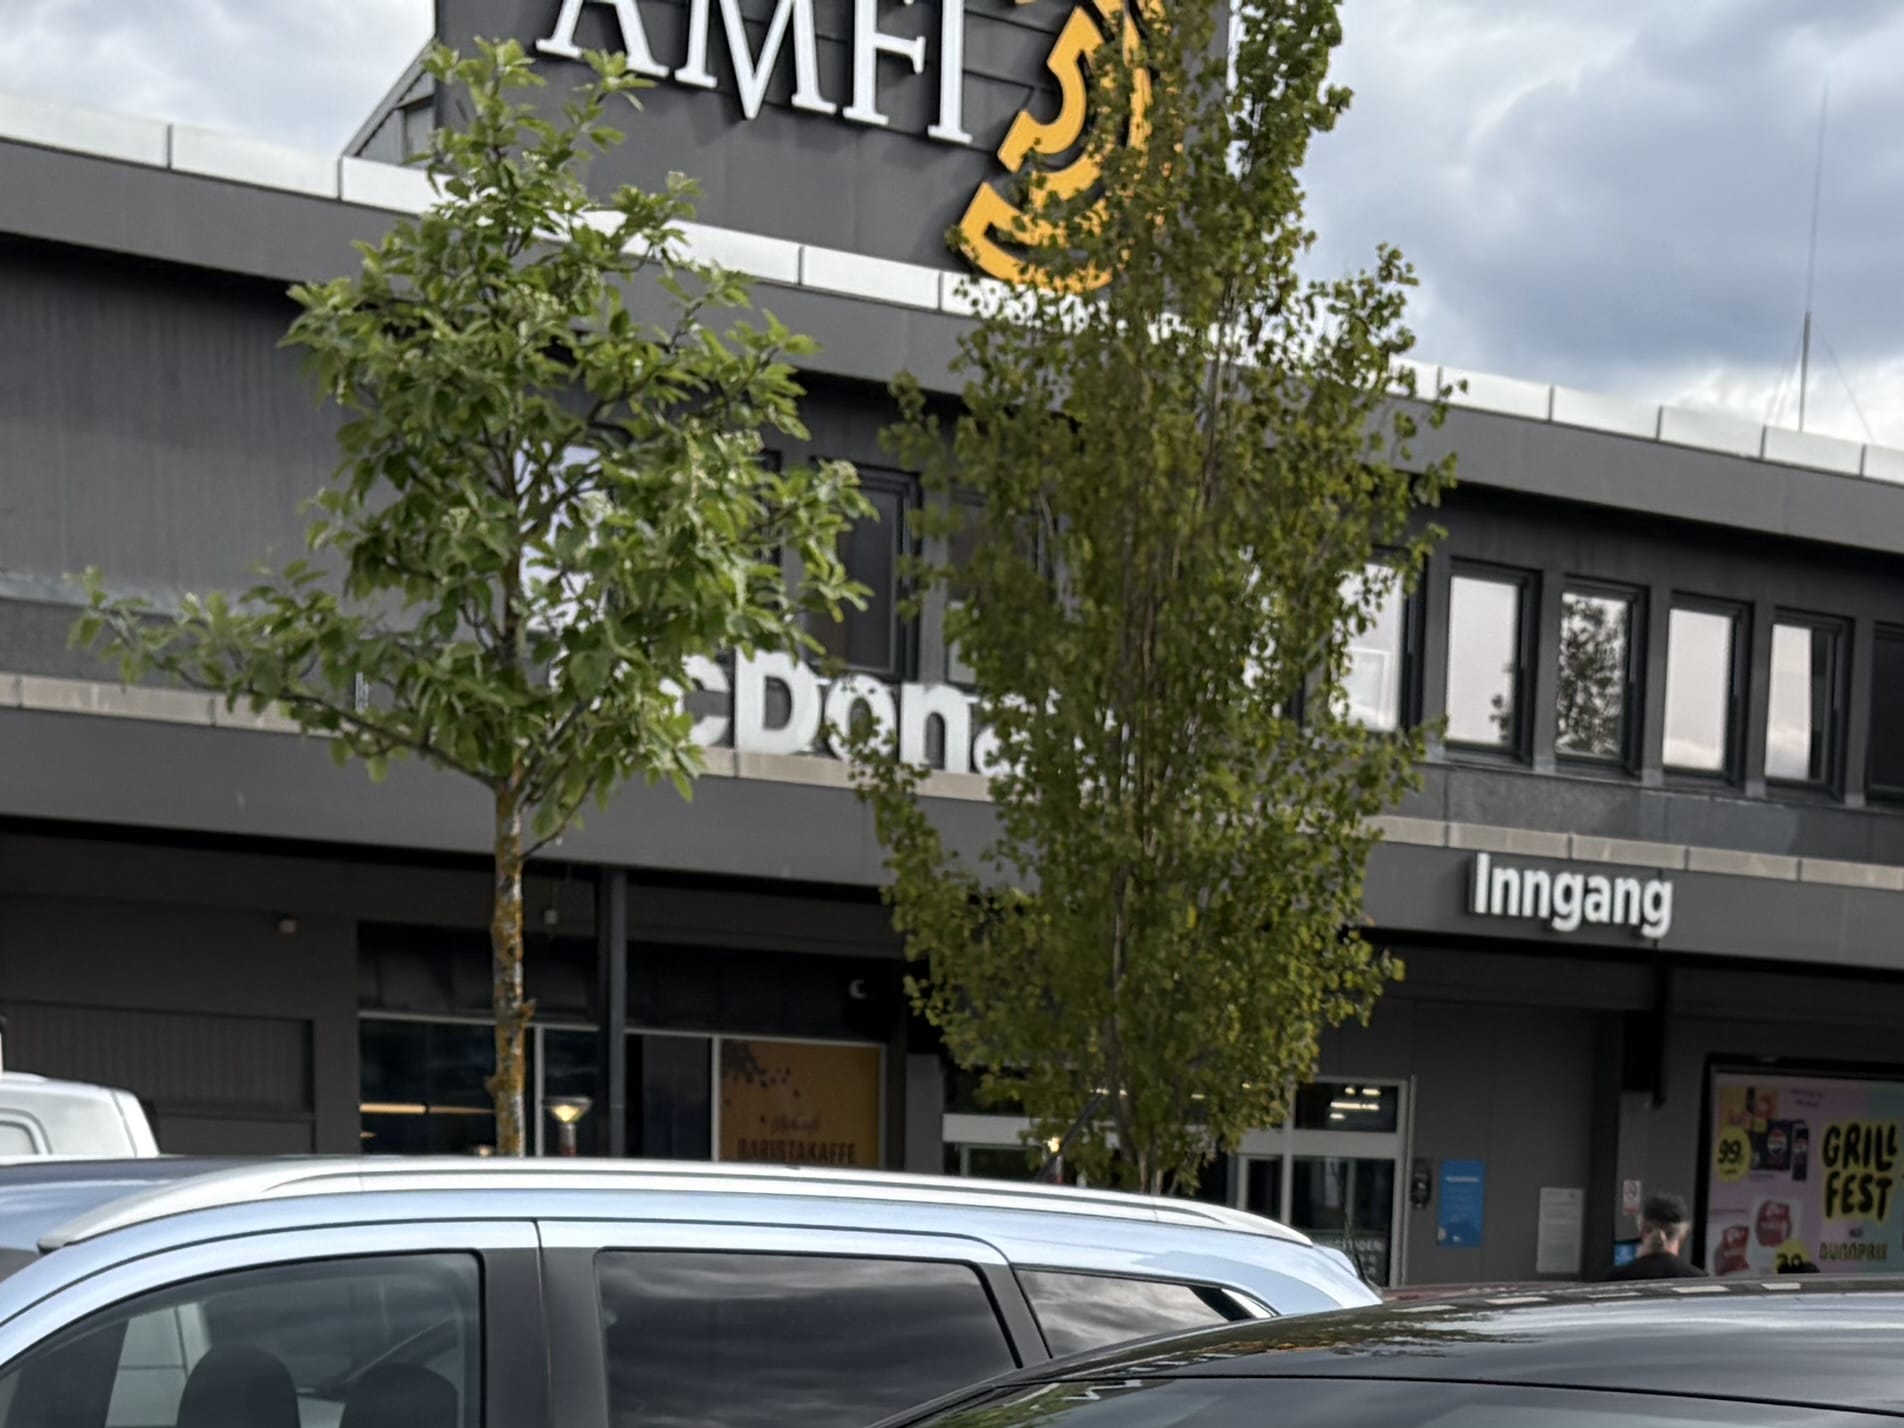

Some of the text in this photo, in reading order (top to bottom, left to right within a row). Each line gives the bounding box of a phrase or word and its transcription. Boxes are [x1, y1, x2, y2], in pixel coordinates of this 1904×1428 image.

[1474, 852, 1673, 939] Inngang
[1821, 1122, 1899, 1173] GRILL
[1824, 1172, 1894, 1222] FEST
